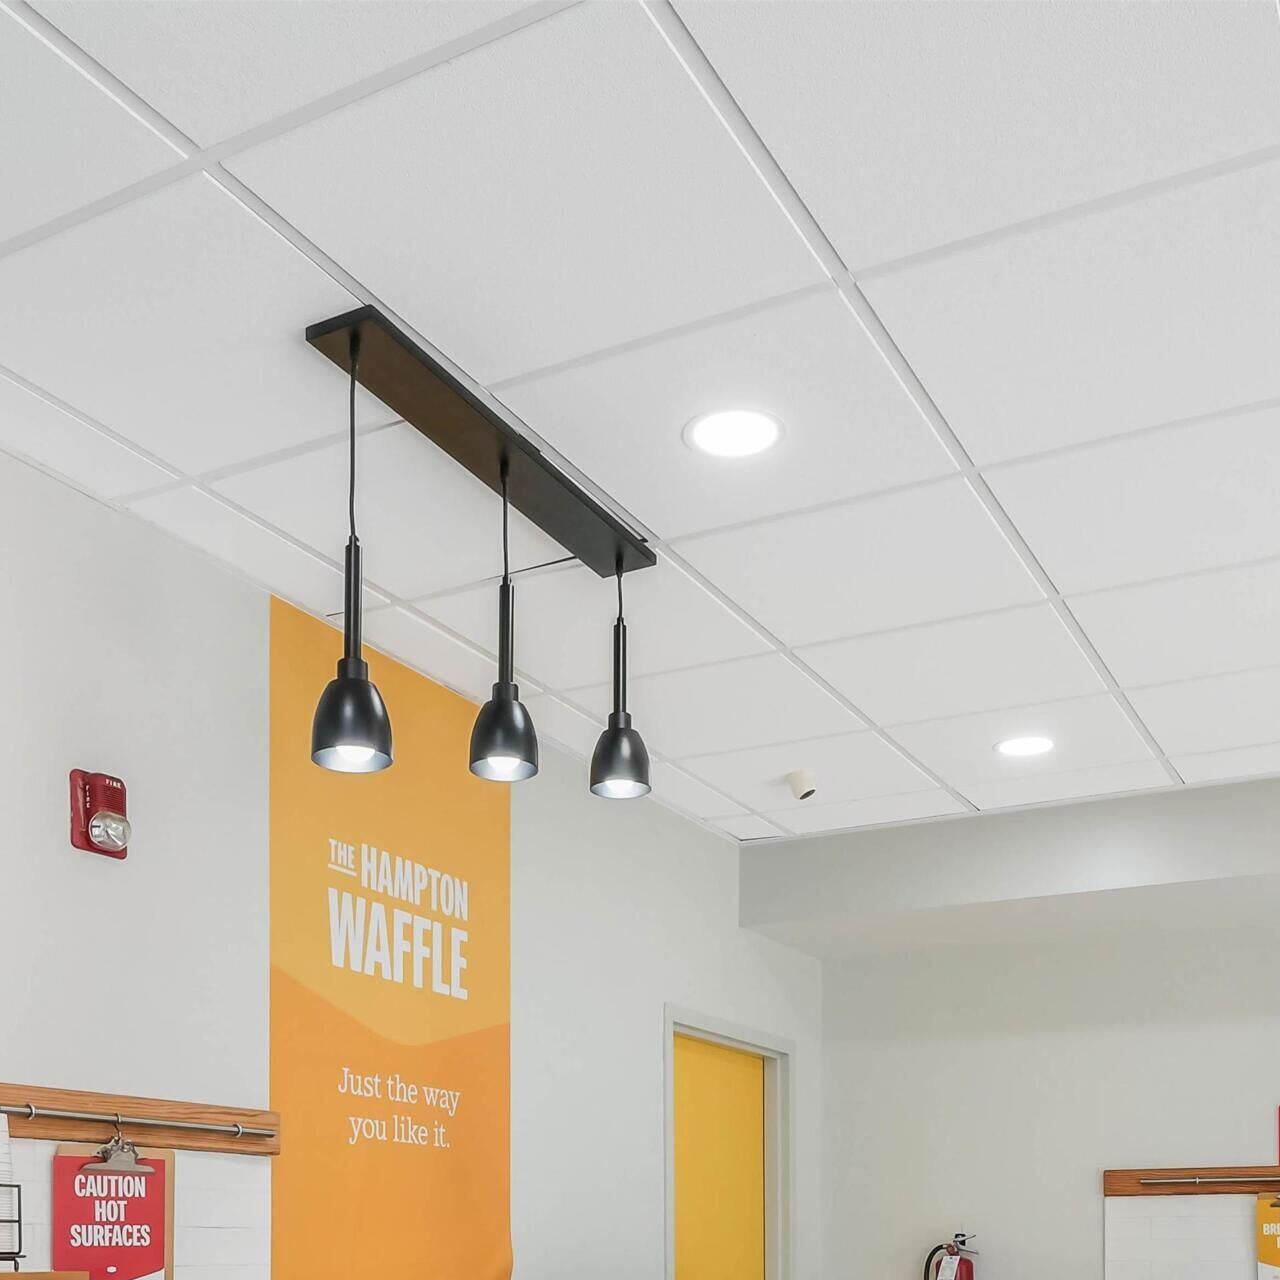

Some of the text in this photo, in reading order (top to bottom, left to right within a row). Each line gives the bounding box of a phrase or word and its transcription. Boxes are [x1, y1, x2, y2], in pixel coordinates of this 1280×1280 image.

[328, 838, 468, 922] THE HAMPTON
[328, 887, 468, 1000] WAFFLE
[338, 1067, 460, 1117] Just the way
[348, 1114, 451, 1148] you like it.
[74, 1174, 146, 1198] CAUTION
[94, 1199, 128, 1222] HOT
[69, 1224, 151, 1247] SURFACES
